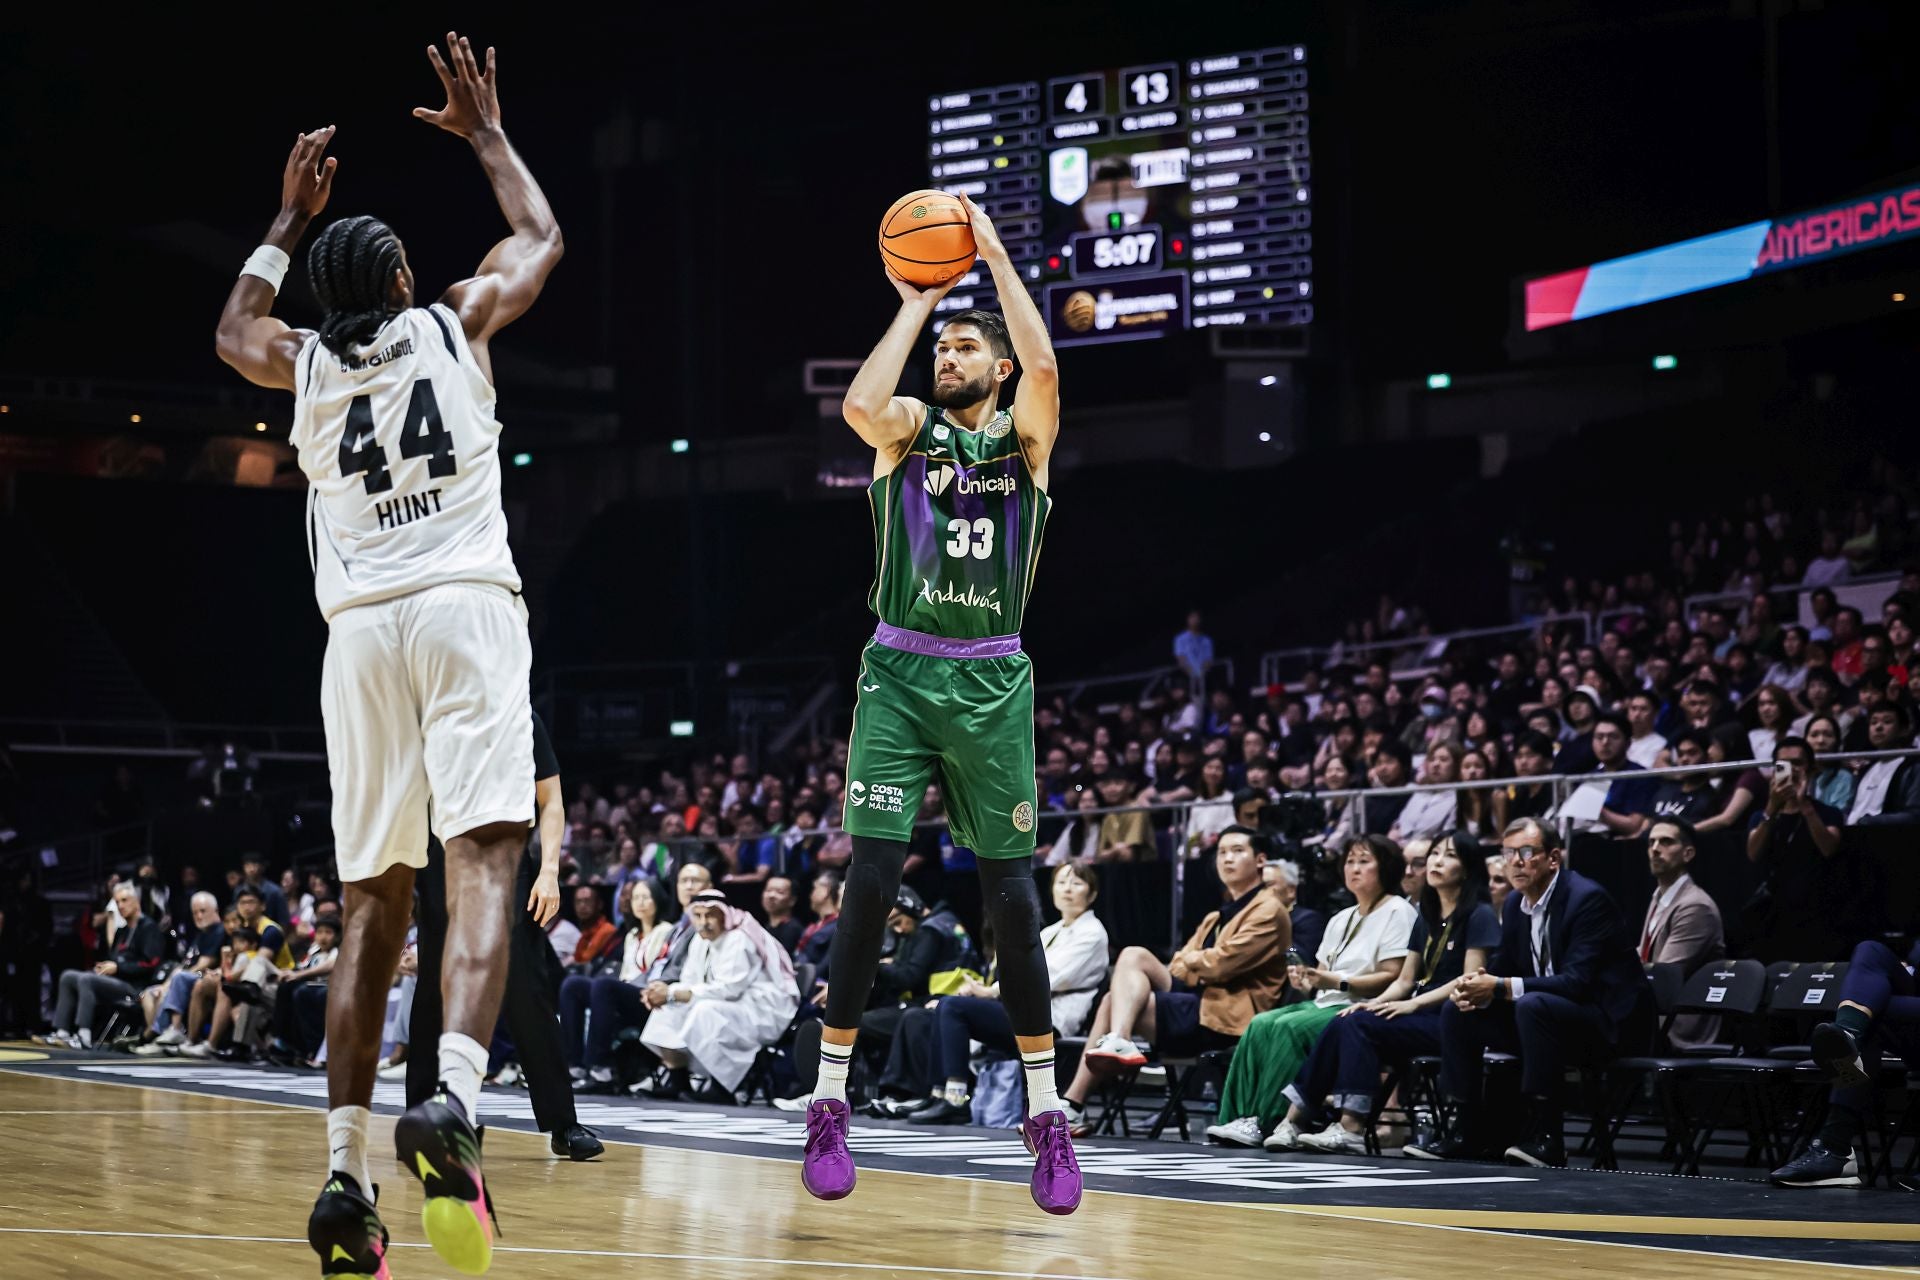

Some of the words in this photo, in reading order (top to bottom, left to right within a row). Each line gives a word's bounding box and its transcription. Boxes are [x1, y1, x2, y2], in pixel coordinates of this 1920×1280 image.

[1064, 82, 1088, 112] 4
[1131, 72, 1170, 106] 13
[1757, 189, 1920, 268] AMERICAS
[1094, 233, 1156, 268] 5:07
[382, 339, 415, 364] LEAGUE
[338, 378, 457, 496] 44
[957, 473, 1016, 497] Unicaja
[375, 488, 443, 531] HUNT
[946, 517, 995, 560] 33
[869, 793, 887, 803] DEL
[888, 795, 904, 806] SOL
[870, 783, 904, 798] COSTA
[868, 802, 903, 813] MÁLAGA
